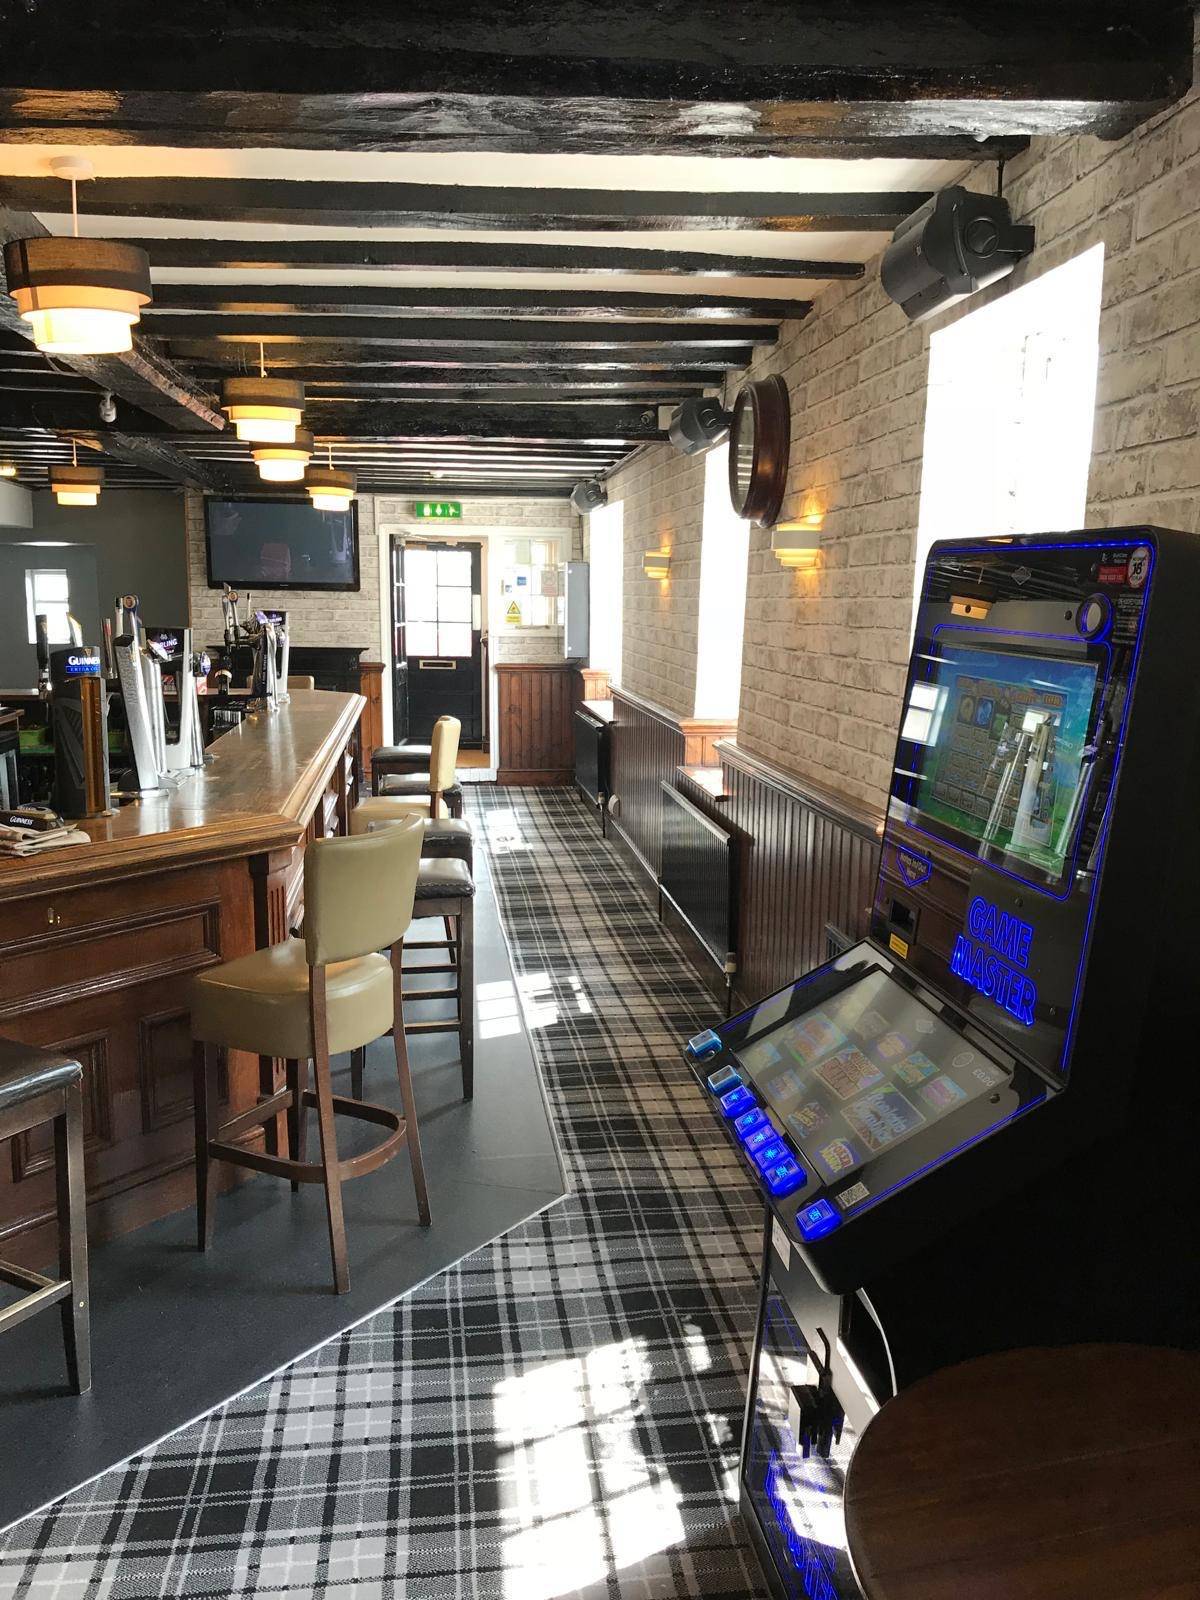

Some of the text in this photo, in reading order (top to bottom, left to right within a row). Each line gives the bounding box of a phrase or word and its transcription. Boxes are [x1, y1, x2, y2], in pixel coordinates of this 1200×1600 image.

[68, 655, 100, 666] GUINNE
[968, 896, 1034, 969] GAME
[950, 933, 1037, 1026] MASTER
